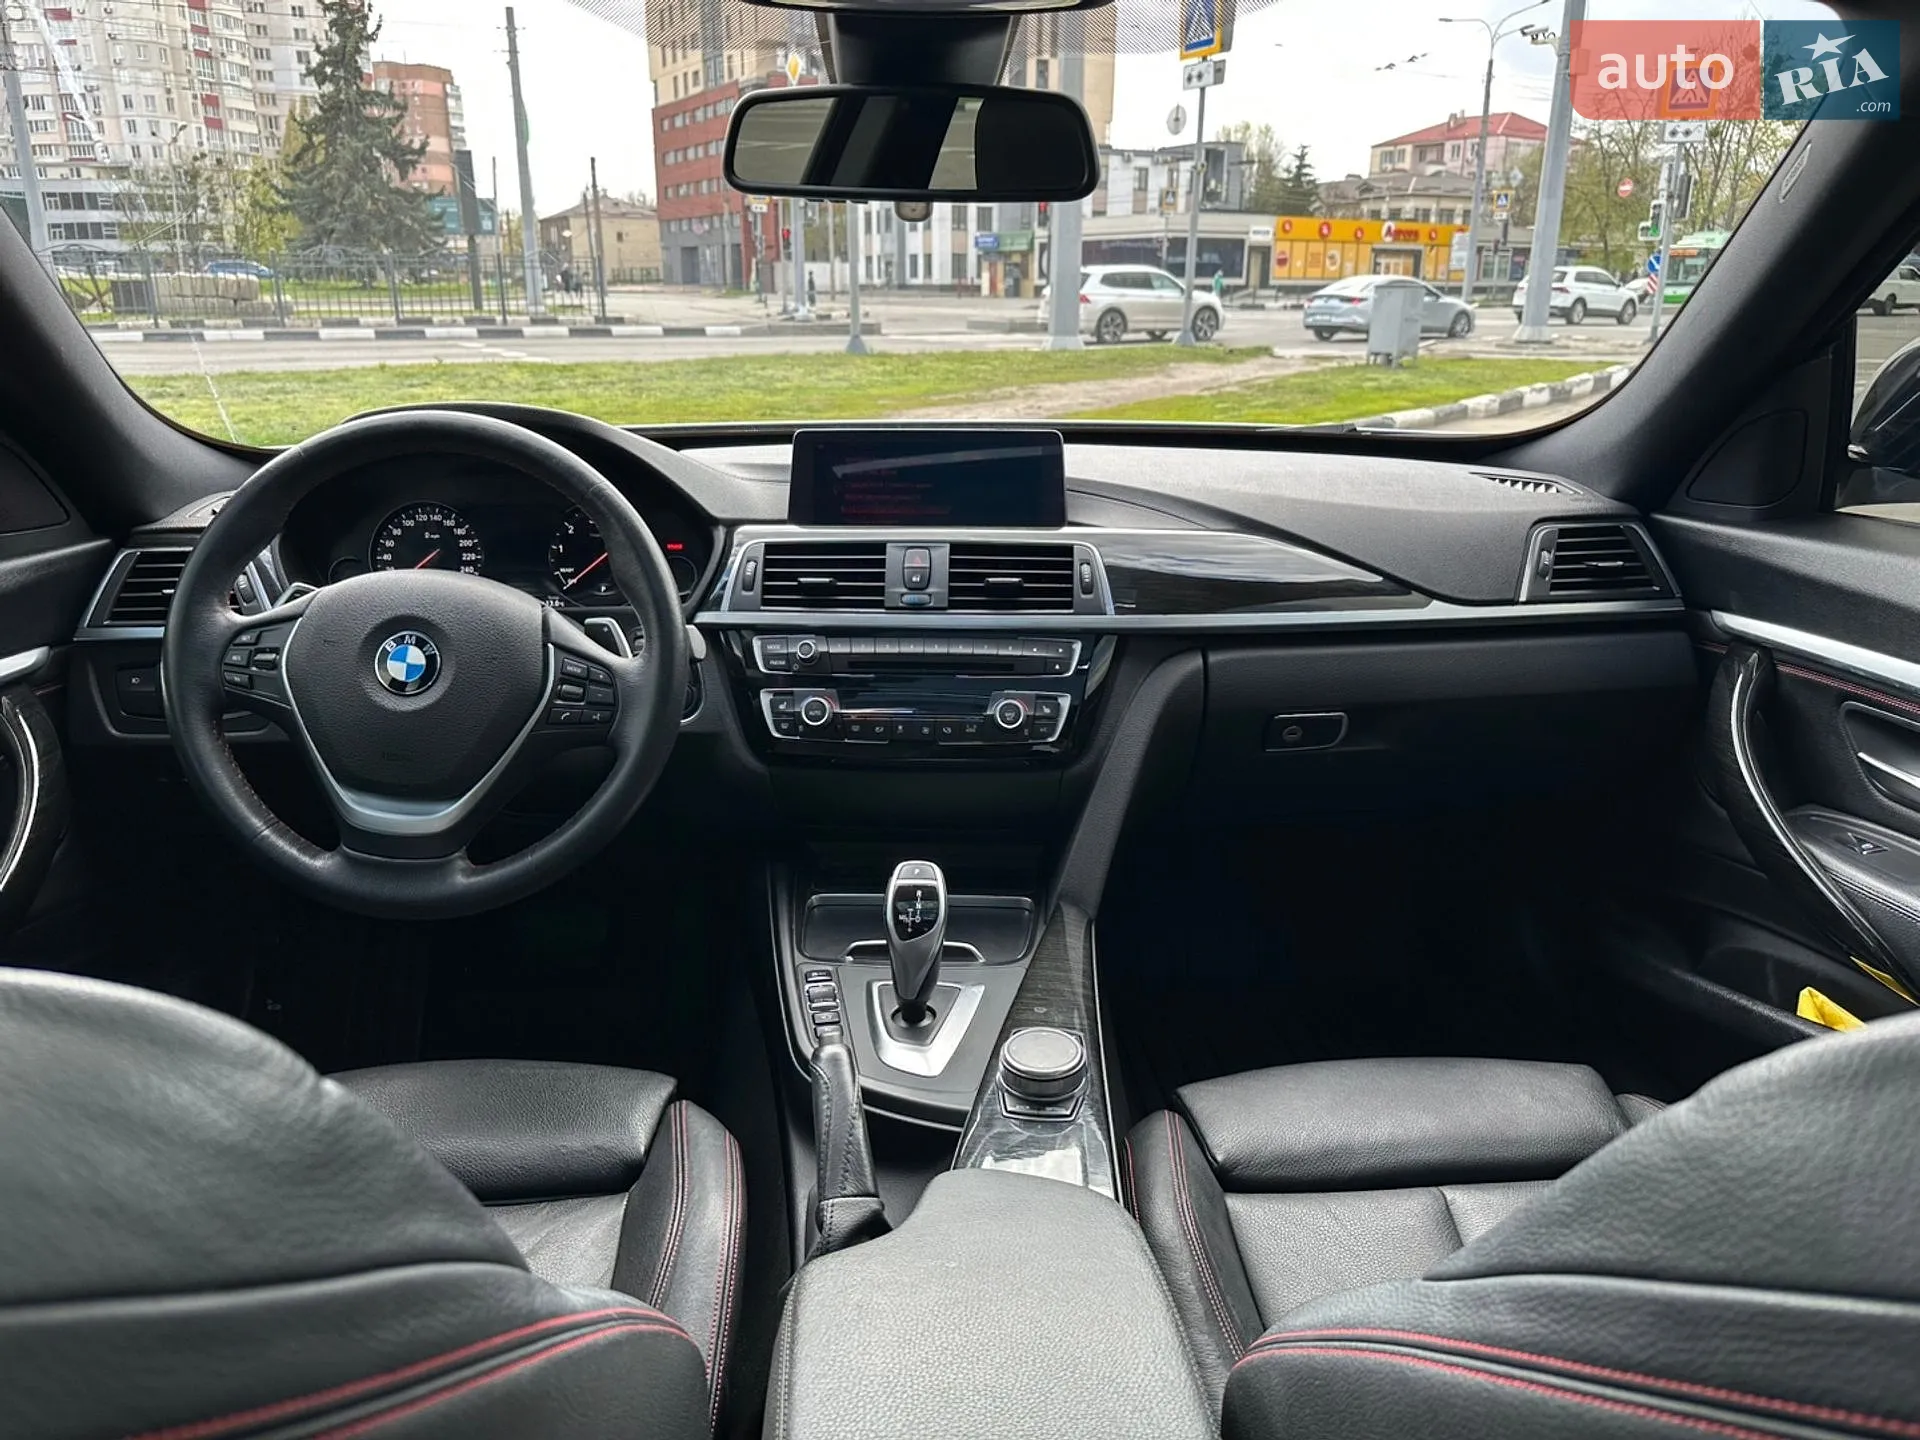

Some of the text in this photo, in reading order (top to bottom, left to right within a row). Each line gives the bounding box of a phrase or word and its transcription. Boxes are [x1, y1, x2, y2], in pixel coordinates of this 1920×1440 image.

[567, 525, 575, 534] 2
[382, 553, 392, 561] 40
[462, 553, 476, 561] 220
